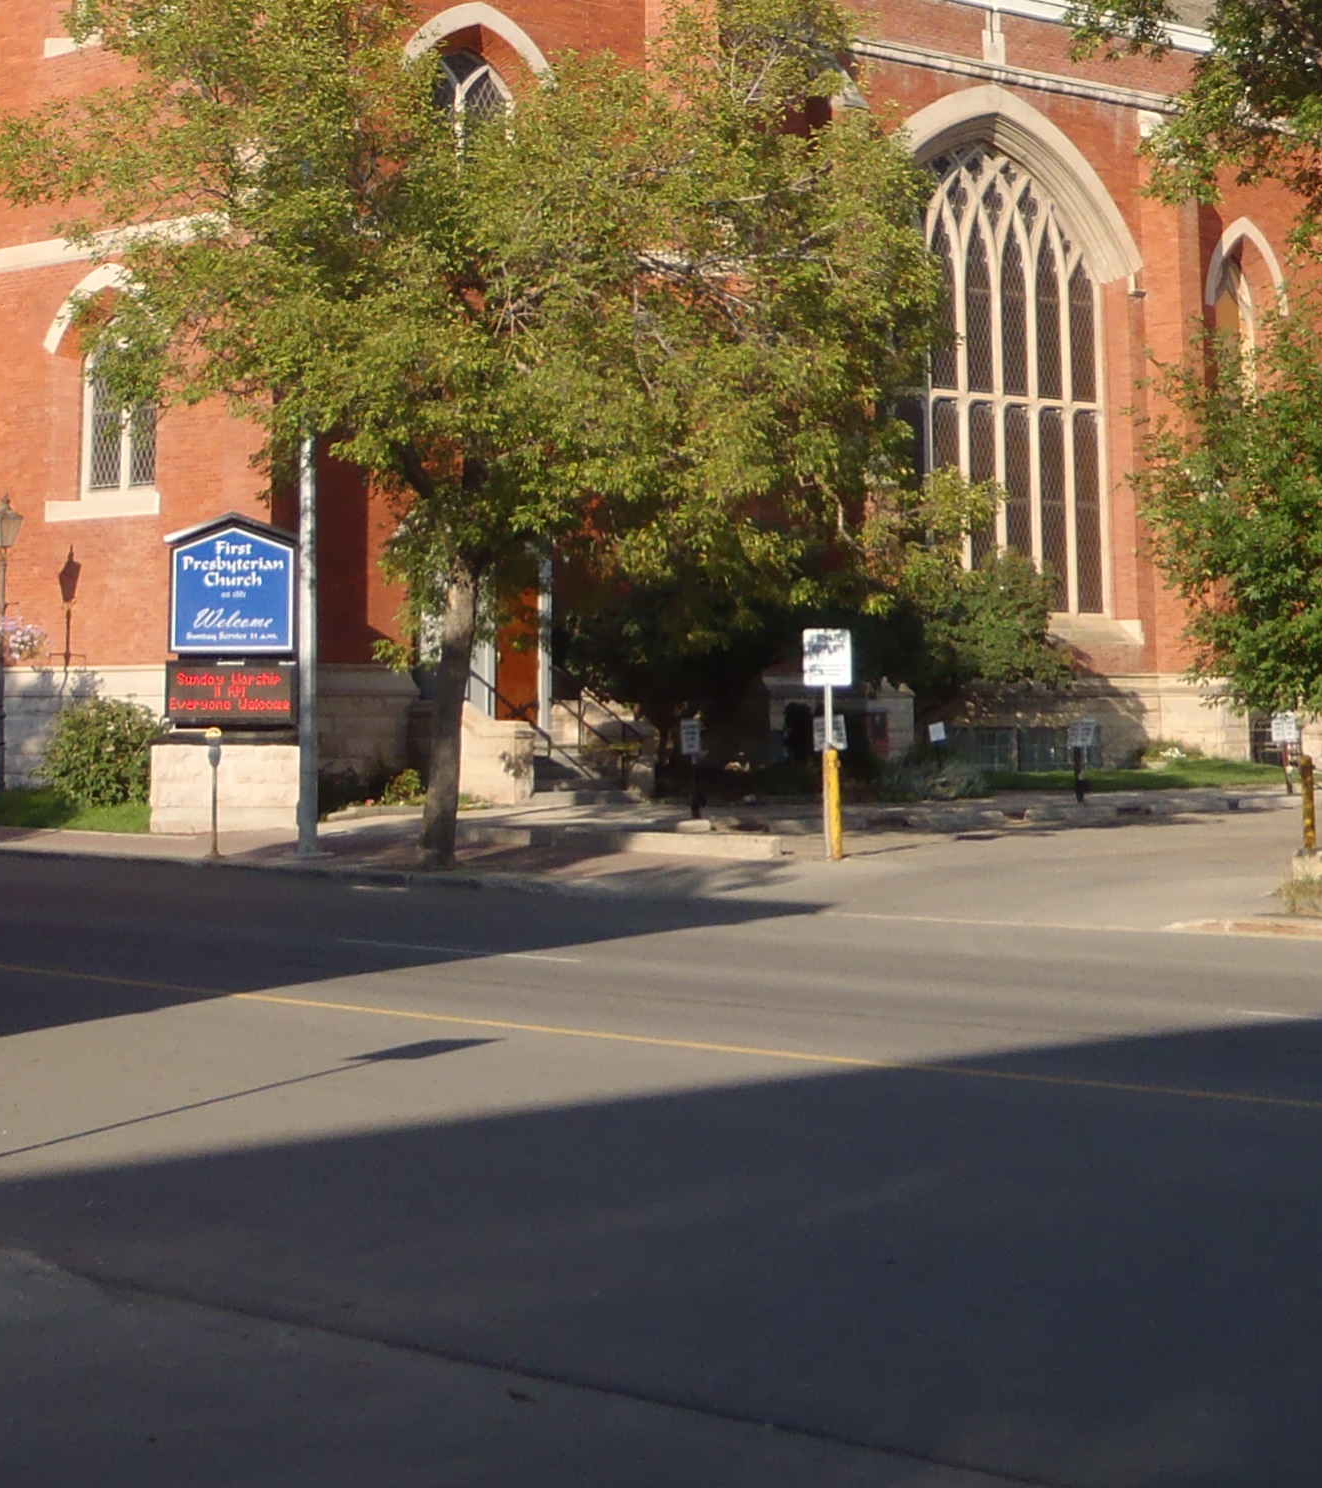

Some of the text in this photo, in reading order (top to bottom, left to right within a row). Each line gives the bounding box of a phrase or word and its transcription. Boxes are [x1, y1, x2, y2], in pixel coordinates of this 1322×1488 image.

[215, 541, 252, 555] First
[182, 555, 285, 574] Presbyterian
[204, 571, 263, 586] Church
[193, 607, 274, 628] Welcome
[186, 632, 217, 642] Sunday
[218, 632, 247, 640] Service
[177, 672, 281, 685] Sunday Worship
[214, 685, 245, 697] 11 AM
[169, 697, 291, 710] Everyone Welcome
